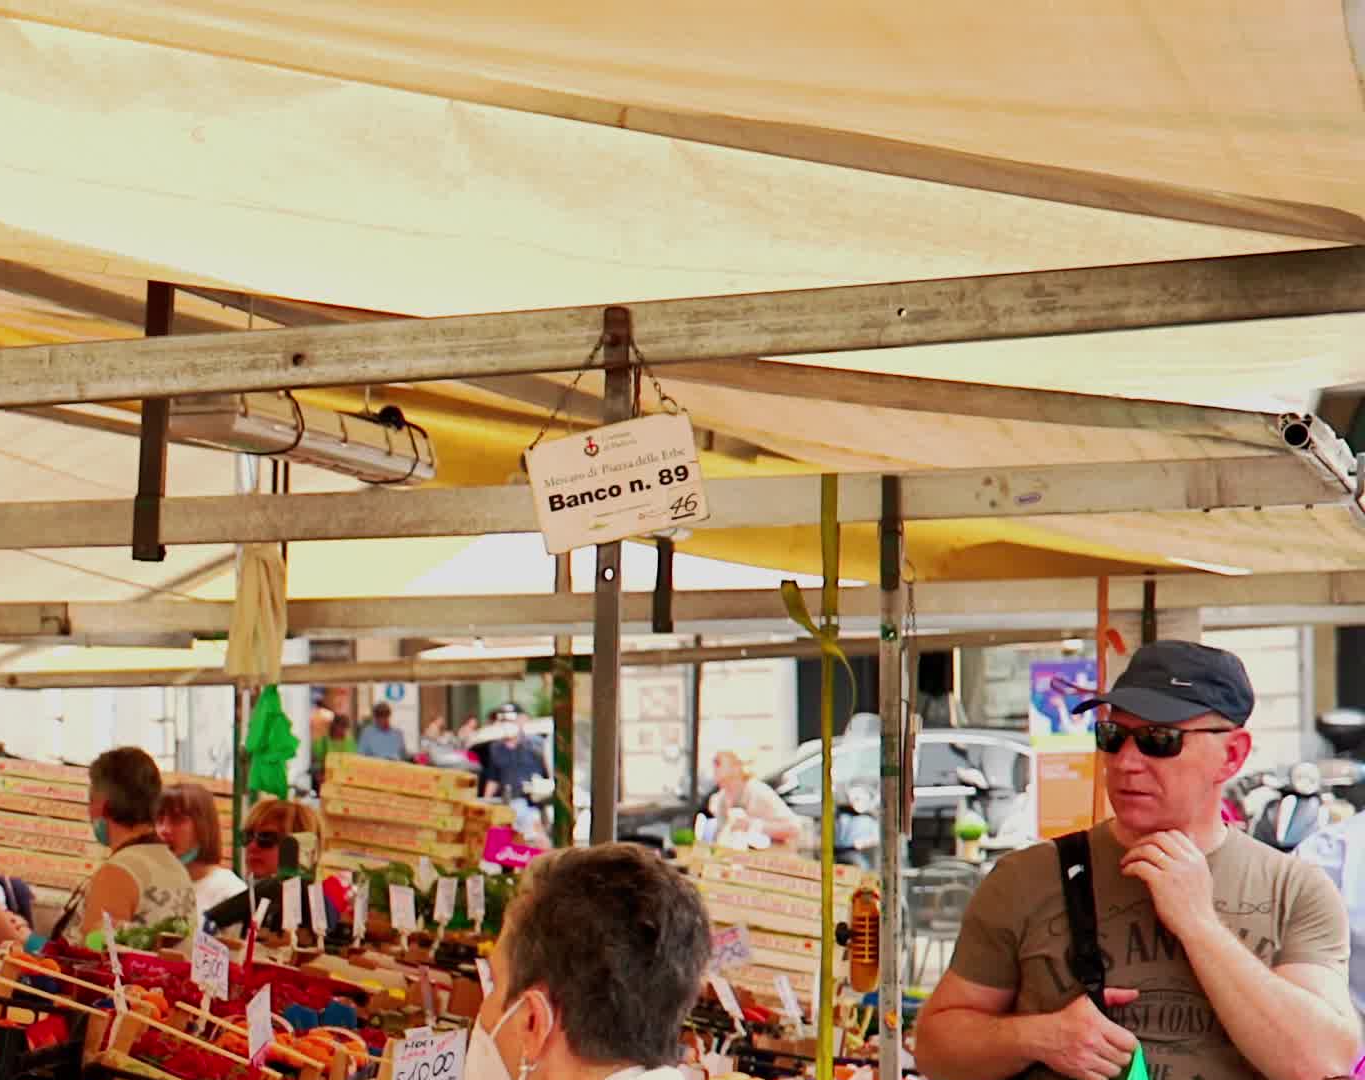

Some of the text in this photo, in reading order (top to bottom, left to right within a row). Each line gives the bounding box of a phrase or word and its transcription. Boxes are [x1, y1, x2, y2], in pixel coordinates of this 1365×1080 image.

[548, 484, 623, 513] Banco
[629, 477, 652, 493] n.
[658, 464, 690, 486] 89
